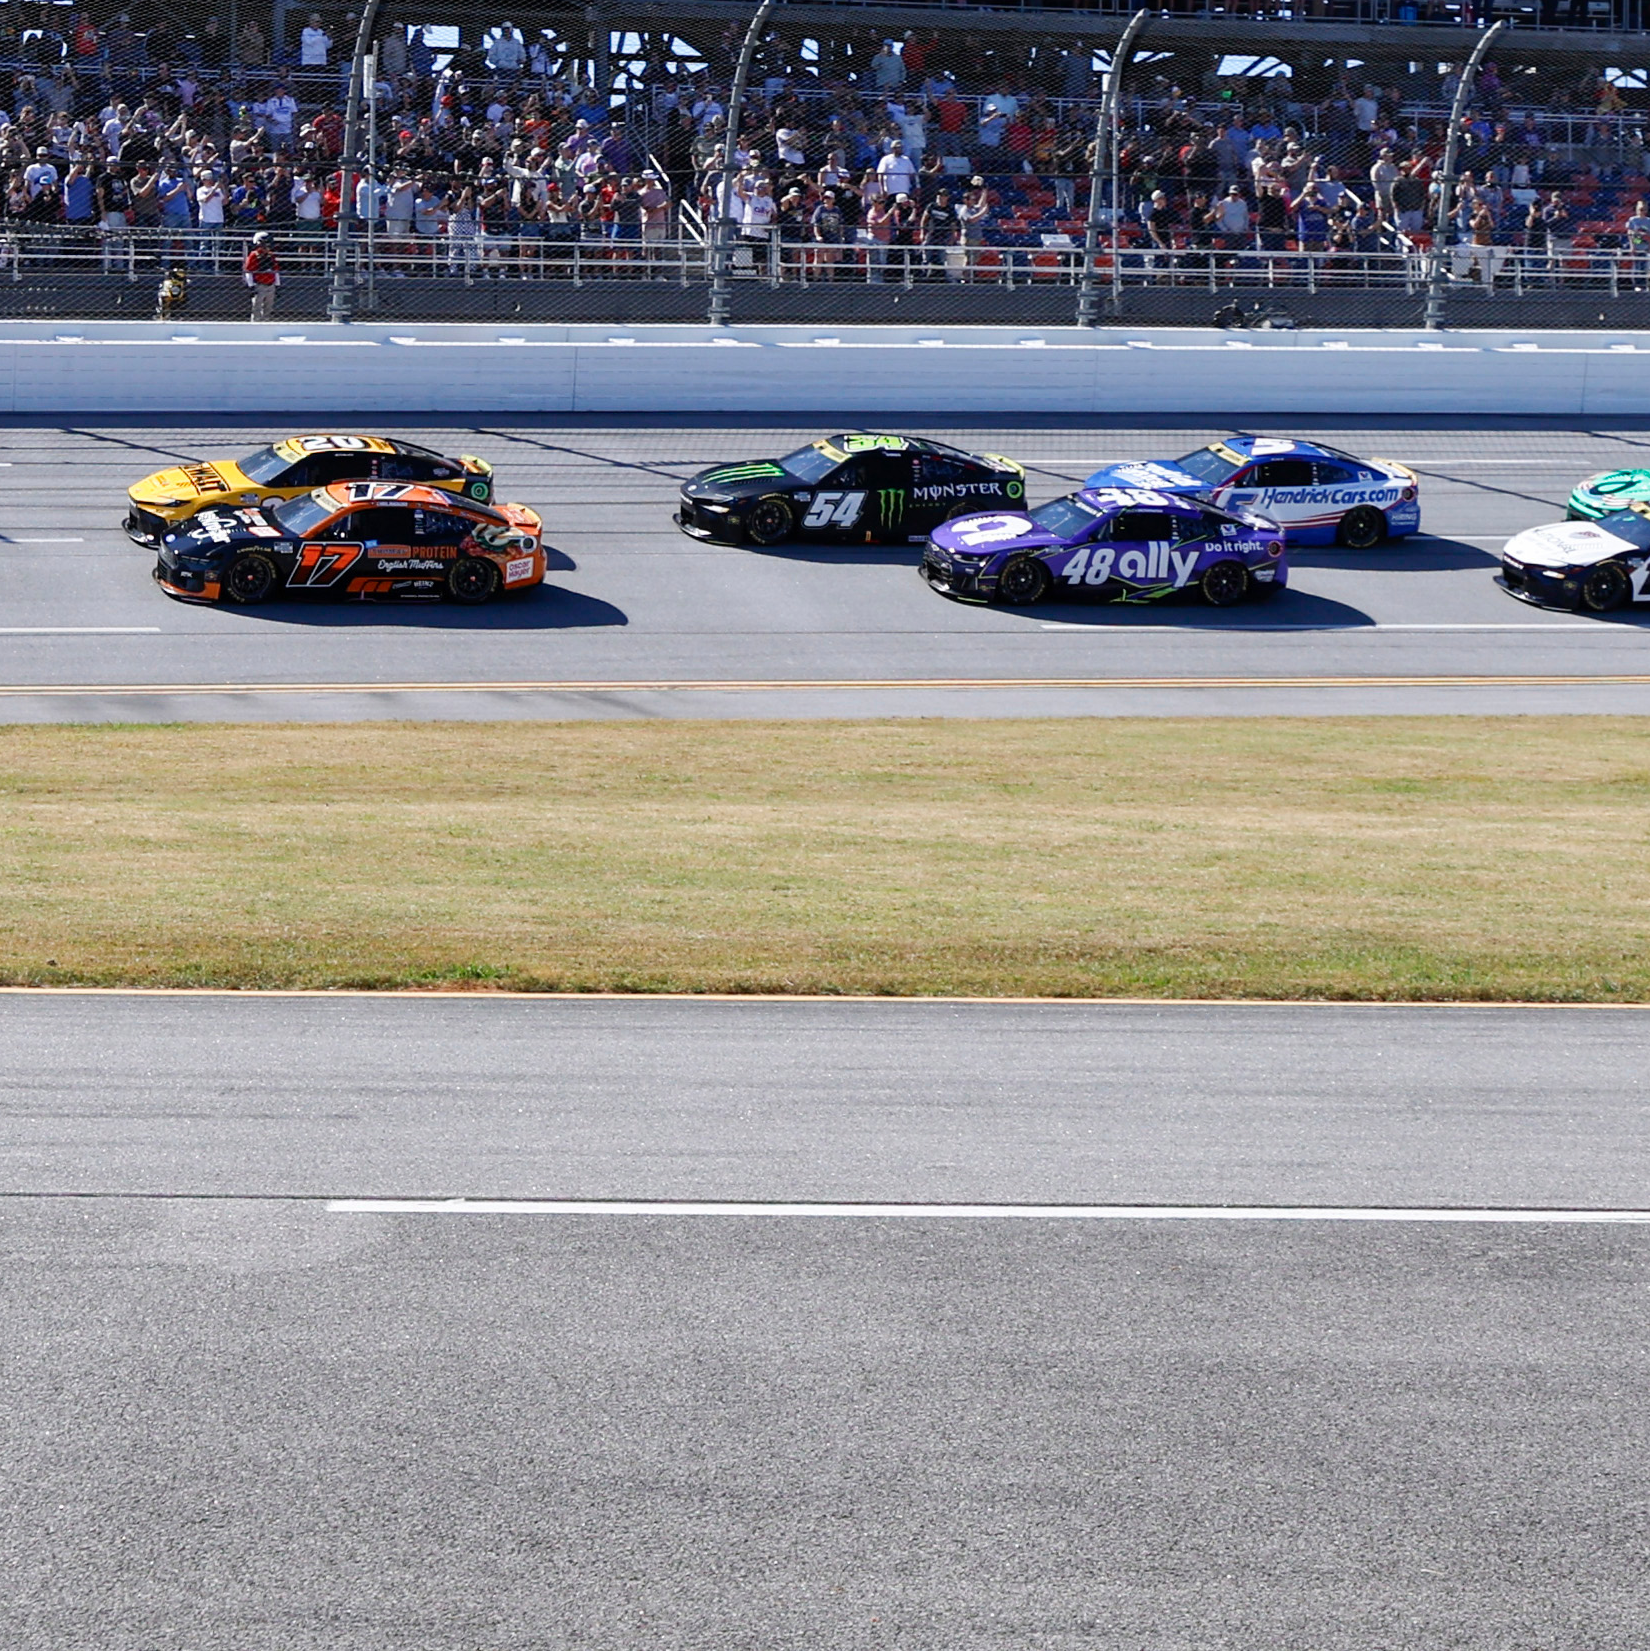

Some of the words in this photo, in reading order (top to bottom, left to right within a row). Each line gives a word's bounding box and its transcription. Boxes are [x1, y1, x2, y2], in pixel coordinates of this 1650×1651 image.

[298, 435, 366, 451] 20
[844, 433, 909, 453] 54
[347, 482, 415, 502] 17
[913, 482, 1003, 500] MONSTER
[1261, 487, 1399, 509] HendrickCars.com
[802, 490, 870, 529] 54
[411, 546, 458, 559] PROTEIN
[1205, 542, 1222, 552] Do
[1223, 540, 1233, 552] it
[1234, 540, 1264, 554] right.
[285, 540, 365, 588] 17
[377, 558, 408, 572] English
[408, 558, 444, 570] Muffins
[1061, 548, 1116, 586] 48
[1118, 541, 1200, 588] ally
[413, 580, 434, 588] HEINZ
